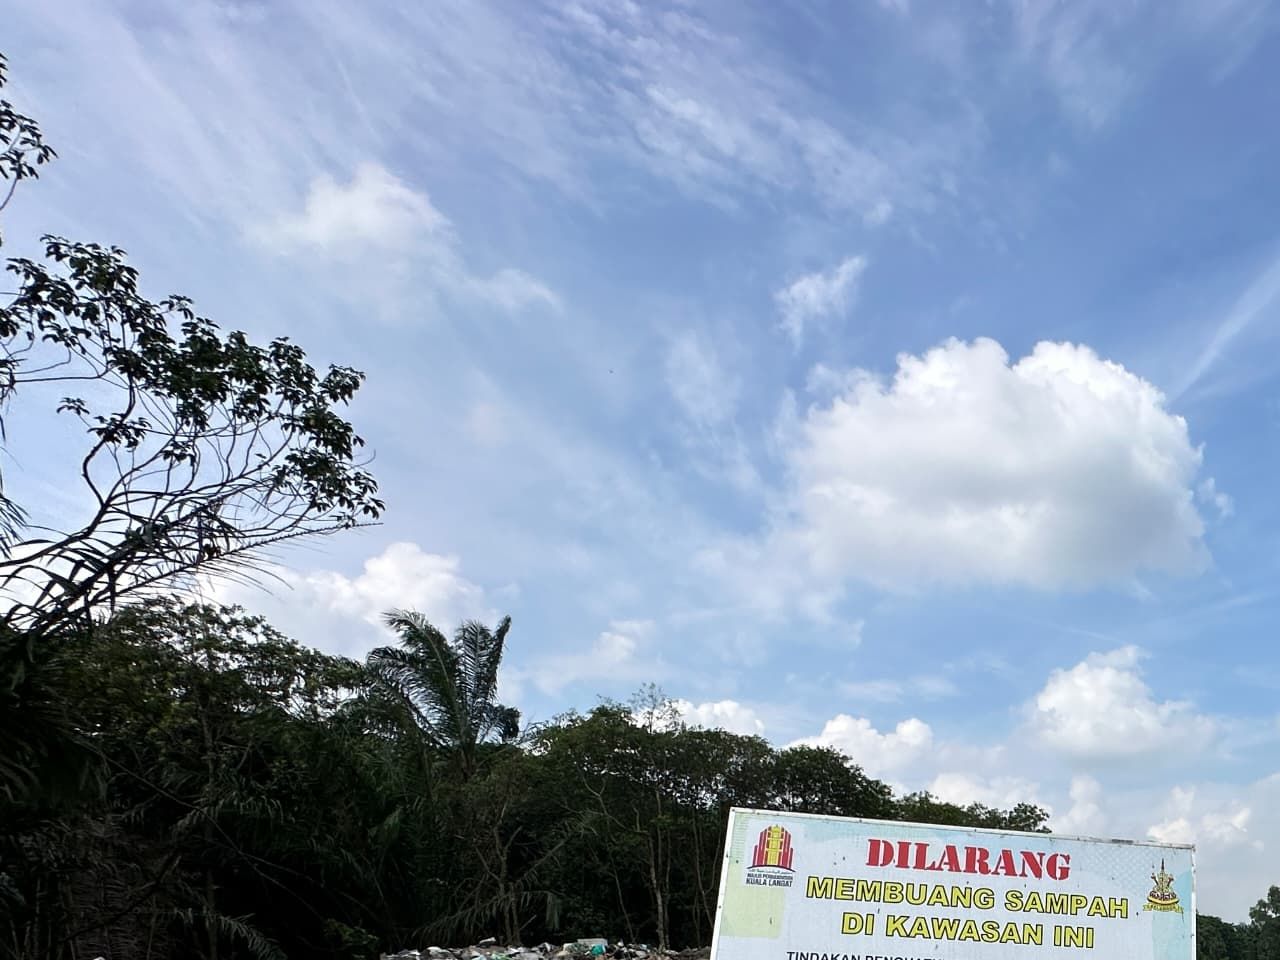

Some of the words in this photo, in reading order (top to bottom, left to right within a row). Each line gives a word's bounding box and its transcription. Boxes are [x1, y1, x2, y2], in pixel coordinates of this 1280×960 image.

[866, 839, 1071, 880] DILARANG
[806, 876, 995, 909] MEMBUANG
[1005, 890, 1128, 919] SAMPAH
[841, 912, 875, 935] DI
[886, 915, 1043, 945] KAWASAN
[1053, 925, 1094, 948] INI
